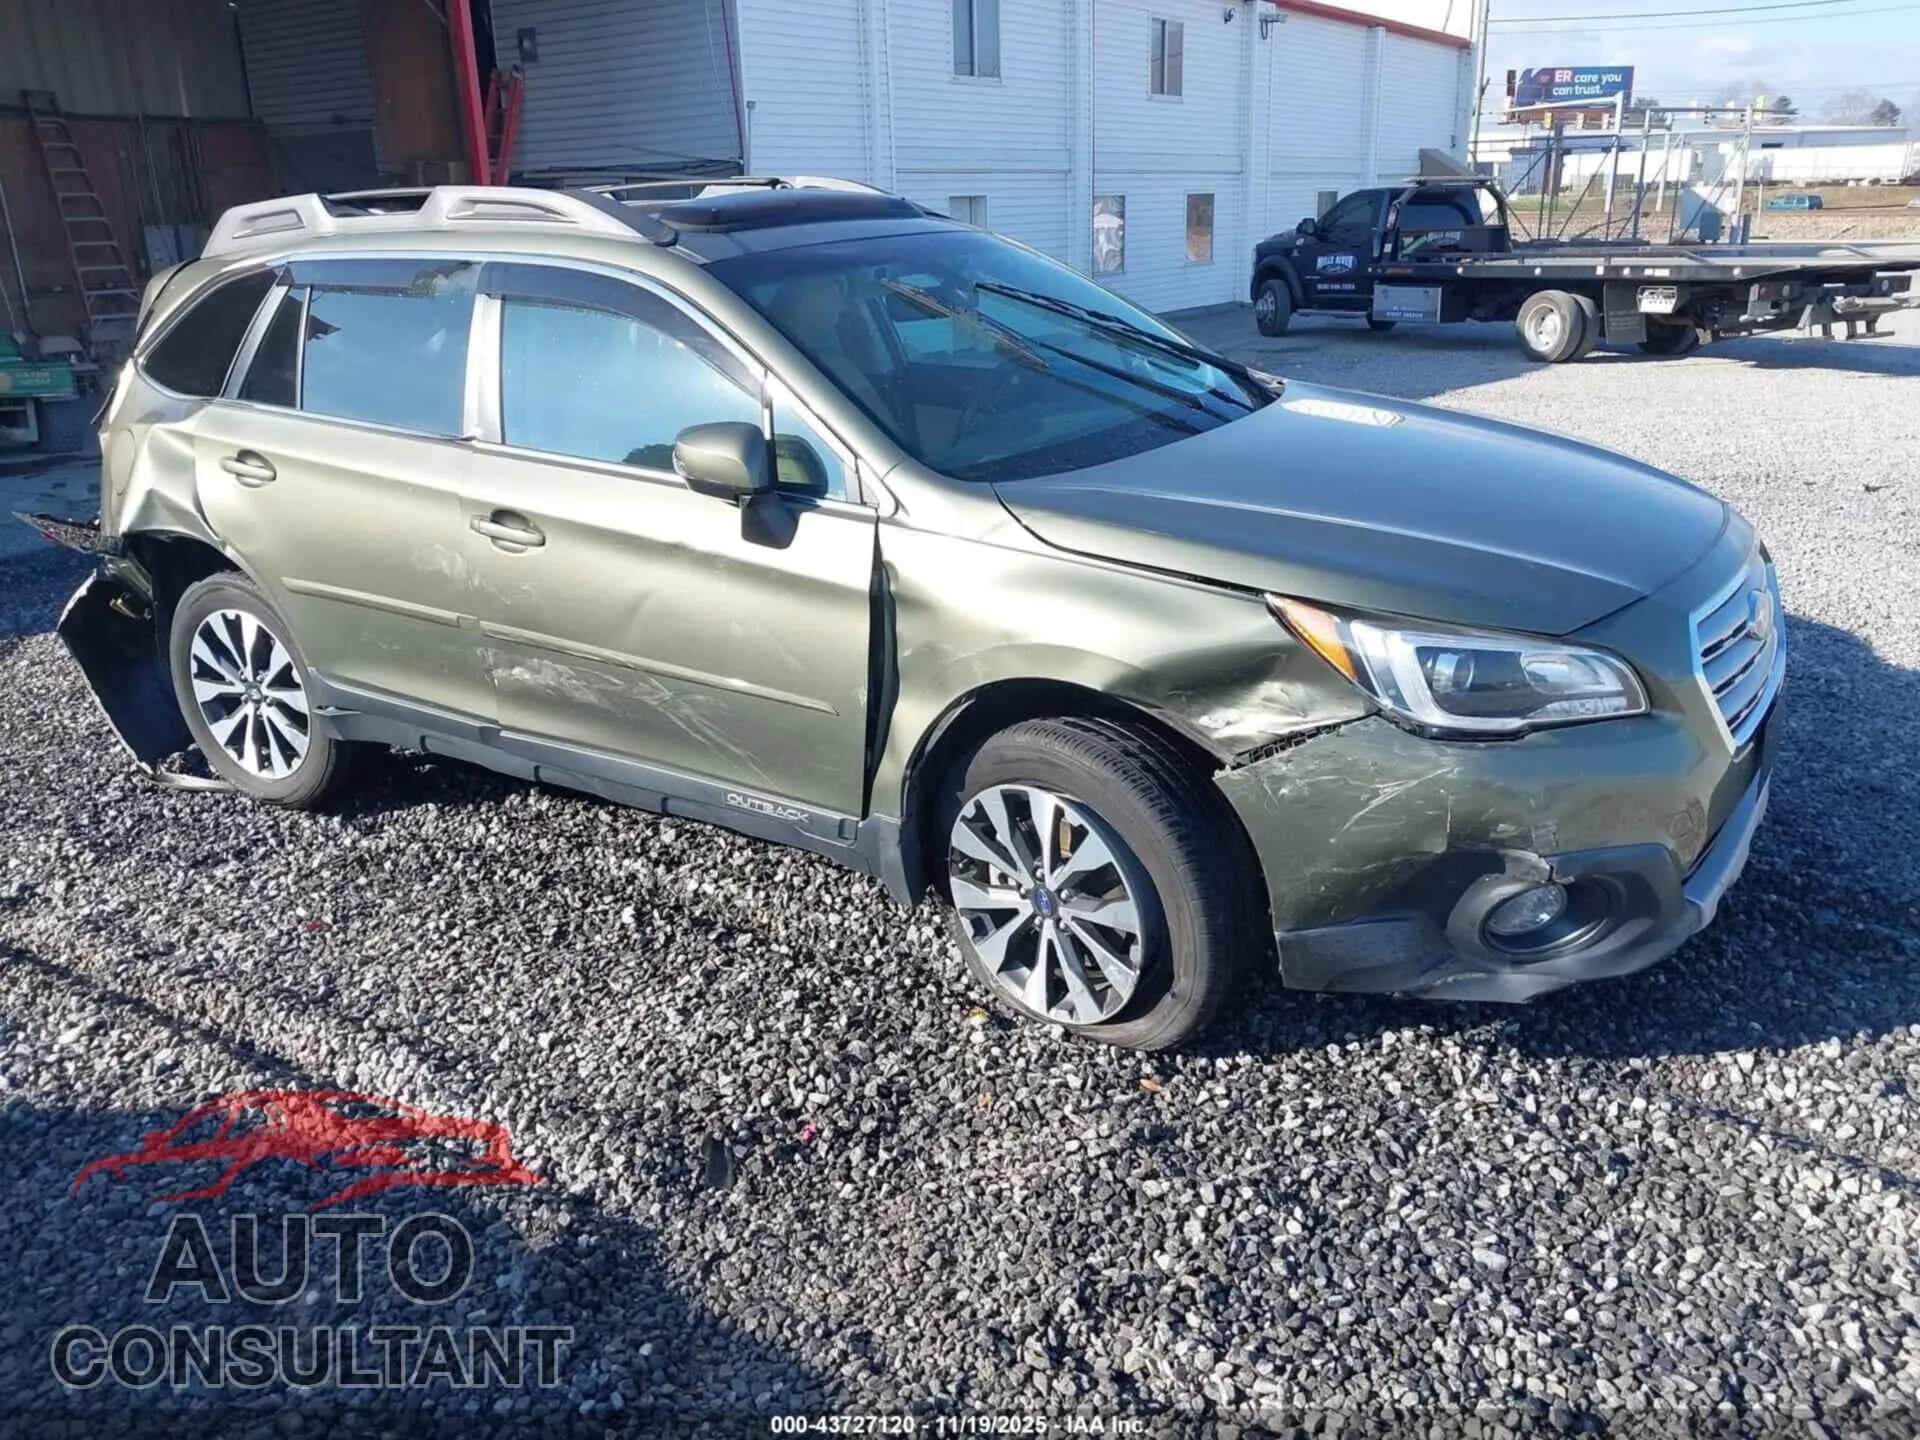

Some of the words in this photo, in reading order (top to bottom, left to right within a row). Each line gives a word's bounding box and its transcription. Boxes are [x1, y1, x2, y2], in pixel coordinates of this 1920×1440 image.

[1554, 69, 1573, 83] ER
[1574, 73, 1599, 83] care
[1600, 72, 1623, 86] you
[1552, 86, 1573, 96] can
[1574, 84, 1604, 96] trust.
[726, 793, 810, 823] OUTBACK
